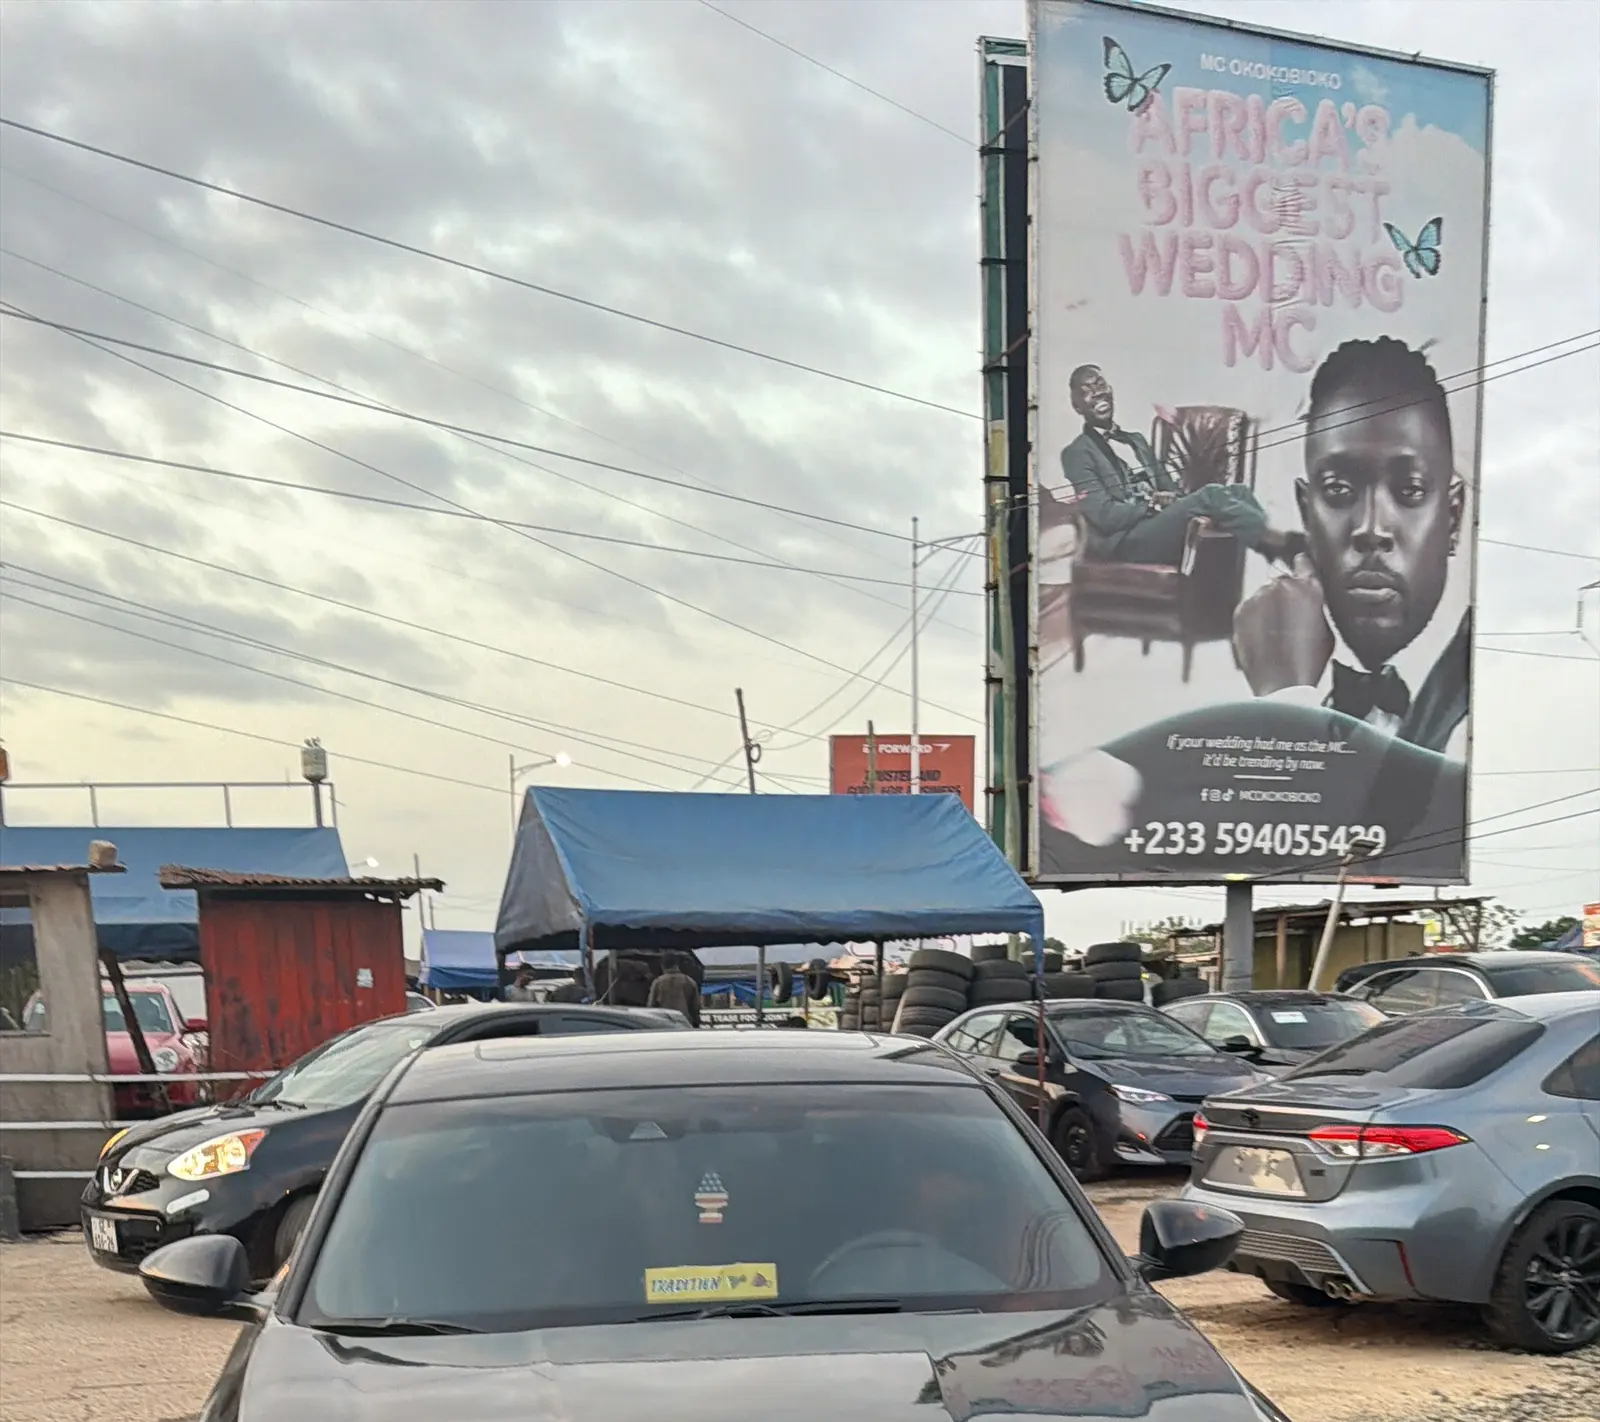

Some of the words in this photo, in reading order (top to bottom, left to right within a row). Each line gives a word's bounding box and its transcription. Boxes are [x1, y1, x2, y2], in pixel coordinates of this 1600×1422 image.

[1200, 53, 1227, 72] MC
[1130, 86, 1391, 175] AFRICA'S
[1138, 158, 1391, 244] BIGGEST
[1117, 229, 1404, 313] WEDDING
[1221, 302, 1317, 374] MC
[878, 743, 933, 754] FORWRD
[1176, 738, 1205, 750] your
[1205, 735, 1253, 752] wedding
[1253, 736, 1277, 750] had
[1275, 741, 1293, 751] me
[1294, 742, 1308, 752] as
[1308, 739, 1328, 752] the
[1222, 754, 1238, 767] be
[1238, 755, 1285, 771] trending
[1285, 756, 1299, 772] by
[1124, 822, 1206, 855] +233
[740, 1013, 759, 1022] FOO
